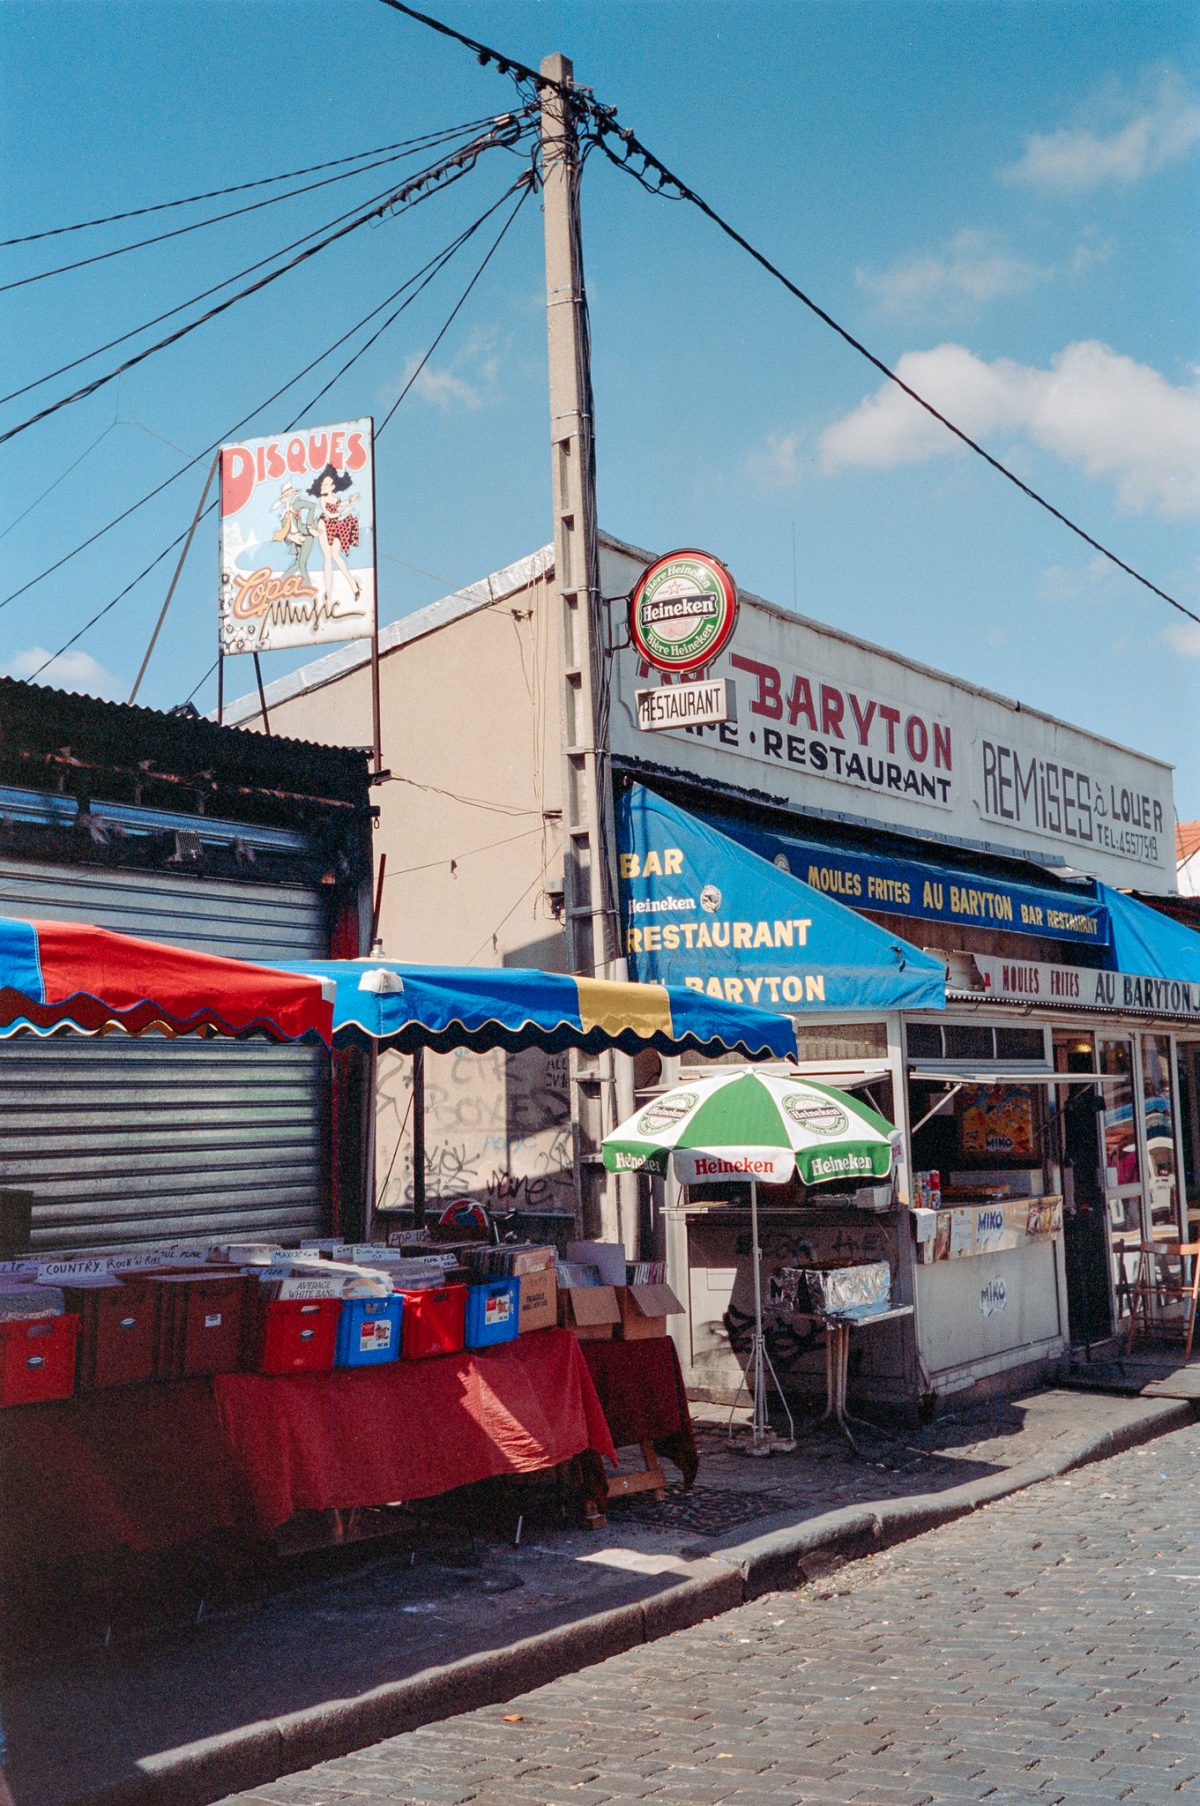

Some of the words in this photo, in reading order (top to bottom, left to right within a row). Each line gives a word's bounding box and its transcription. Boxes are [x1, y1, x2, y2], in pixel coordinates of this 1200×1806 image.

[222, 431, 367, 518] DISQUES
[233, 567, 318, 620] Copa
[259, 598, 365, 641] Music
[643, 599, 715, 622] Heineken
[647, 634, 669, 656] Bière
[671, 624, 714, 656] Heineken
[642, 688, 721, 722] RESTAURANT
[729, 653, 952, 771] BARYTON
[763, 727, 951, 802] RESTAURANT
[1111, 785, 1163, 833] LOUER
[619, 848, 684, 879] BAR
[628, 896, 696, 914] Heineken
[807, 865, 862, 896] MOULES
[868, 876, 911, 905] FRITES
[923, 880, 943, 911] AU
[950, 886, 1013, 921] BARYTON
[1020, 903, 1043, 926] BAR
[625, 919, 811, 953] RESTAURANT
[1002, 965, 1040, 995] MOULES
[1051, 970, 1080, 998] FRITES
[1095, 971, 1116, 1006] AU
[1123, 975, 1191, 1013] BARYTON
[649, 1107, 686, 1118] Heineken
[793, 1108, 842, 1121] Heineken
[986, 1138, 1013, 1147] MIKO
[695, 1157, 774, 1175] Heineken
[811, 1153, 873, 1176] Heineken
[977, 1210, 1003, 1232] MIKO
[289, 1289, 314, 1298] WHITE
[297, 1281, 331, 1290] AVERAGE
[981, 1282, 1006, 1303] MIKO
